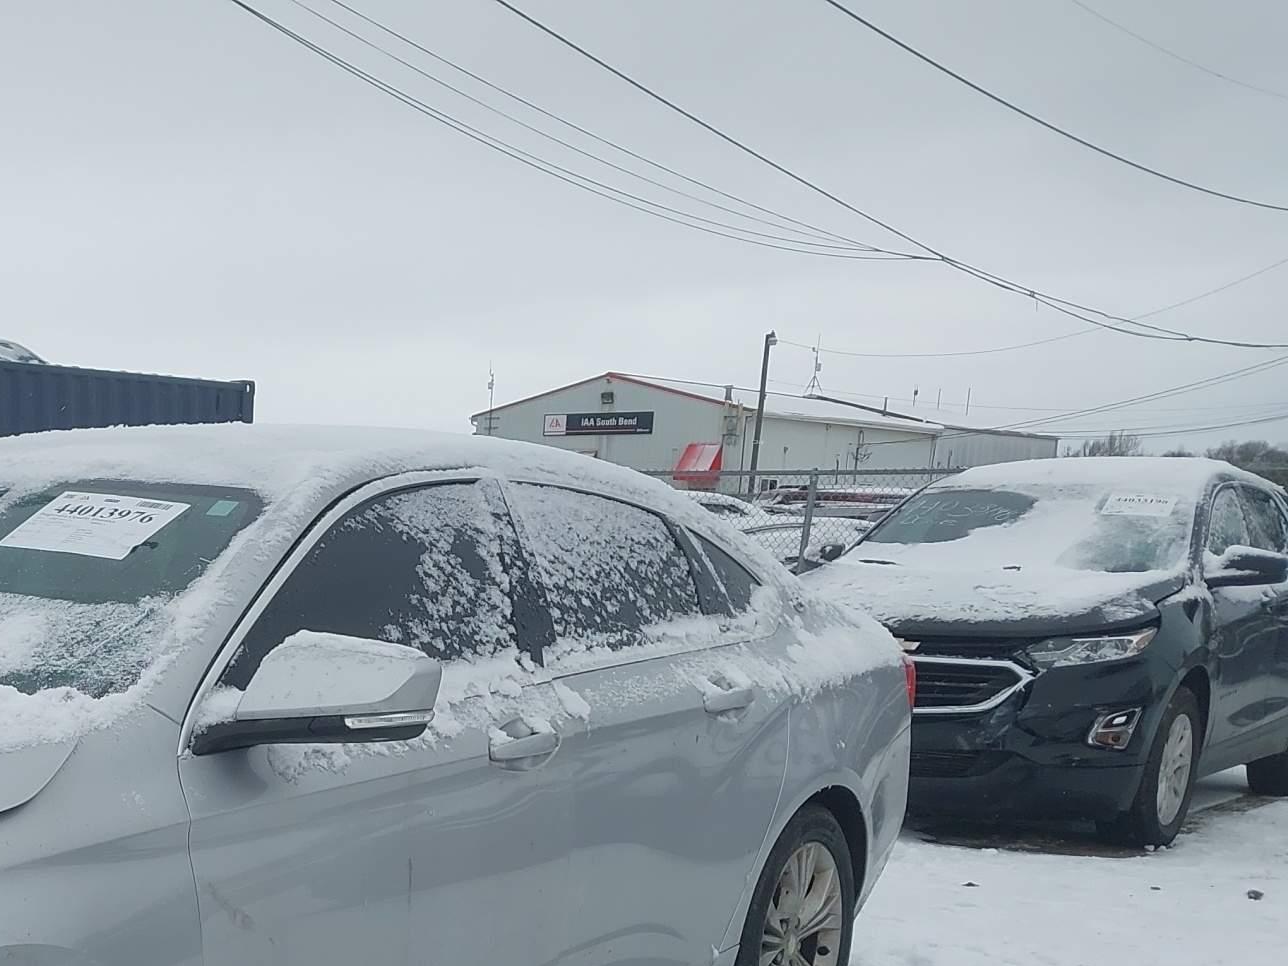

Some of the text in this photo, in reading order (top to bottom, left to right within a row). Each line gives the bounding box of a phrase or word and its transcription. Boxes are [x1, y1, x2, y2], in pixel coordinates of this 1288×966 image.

[580, 416, 638, 427] IAA South Bend
[53, 502, 155, 525] 44013976
